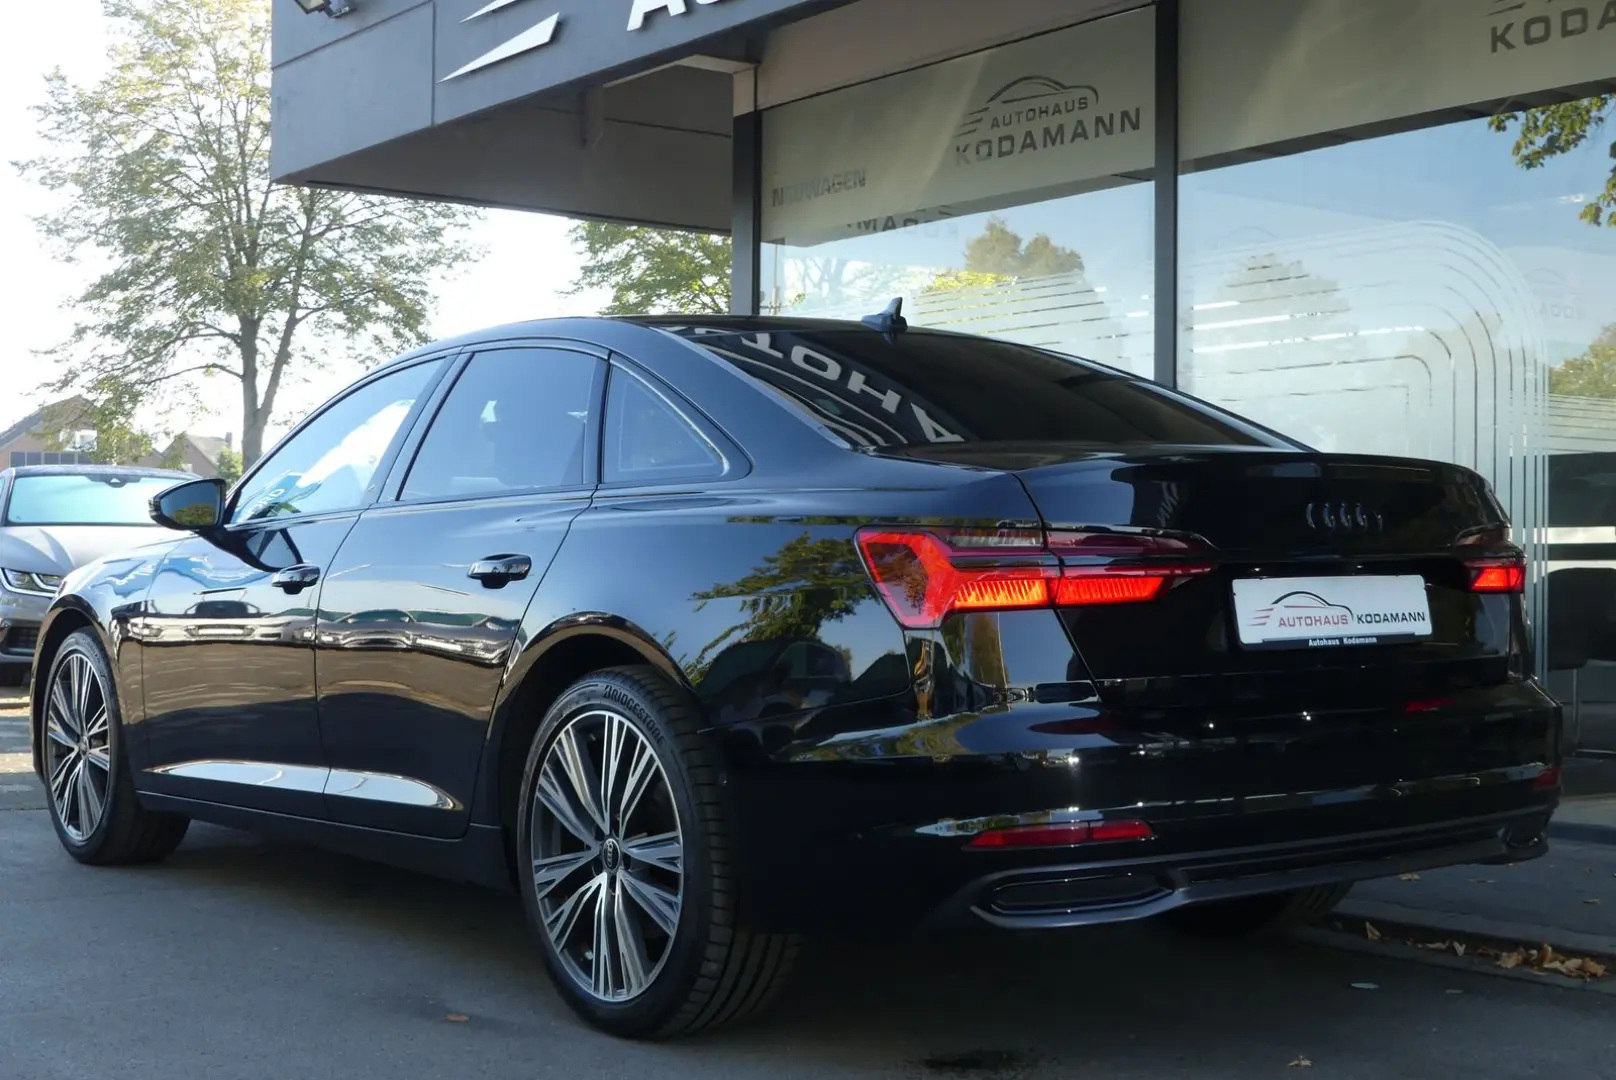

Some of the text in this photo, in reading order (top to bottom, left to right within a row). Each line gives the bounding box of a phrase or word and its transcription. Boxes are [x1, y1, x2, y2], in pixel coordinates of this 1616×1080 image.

[990, 96, 1089, 130] AUTOHAUS
[955, 107, 1141, 166] KODAMANN
[1278, 611, 1426, 628] AUTOHAUS KODAMANN
[1308, 637, 1377, 647] Autohaus Kodamann
[603, 684, 667, 746] BRIDGESTONE
